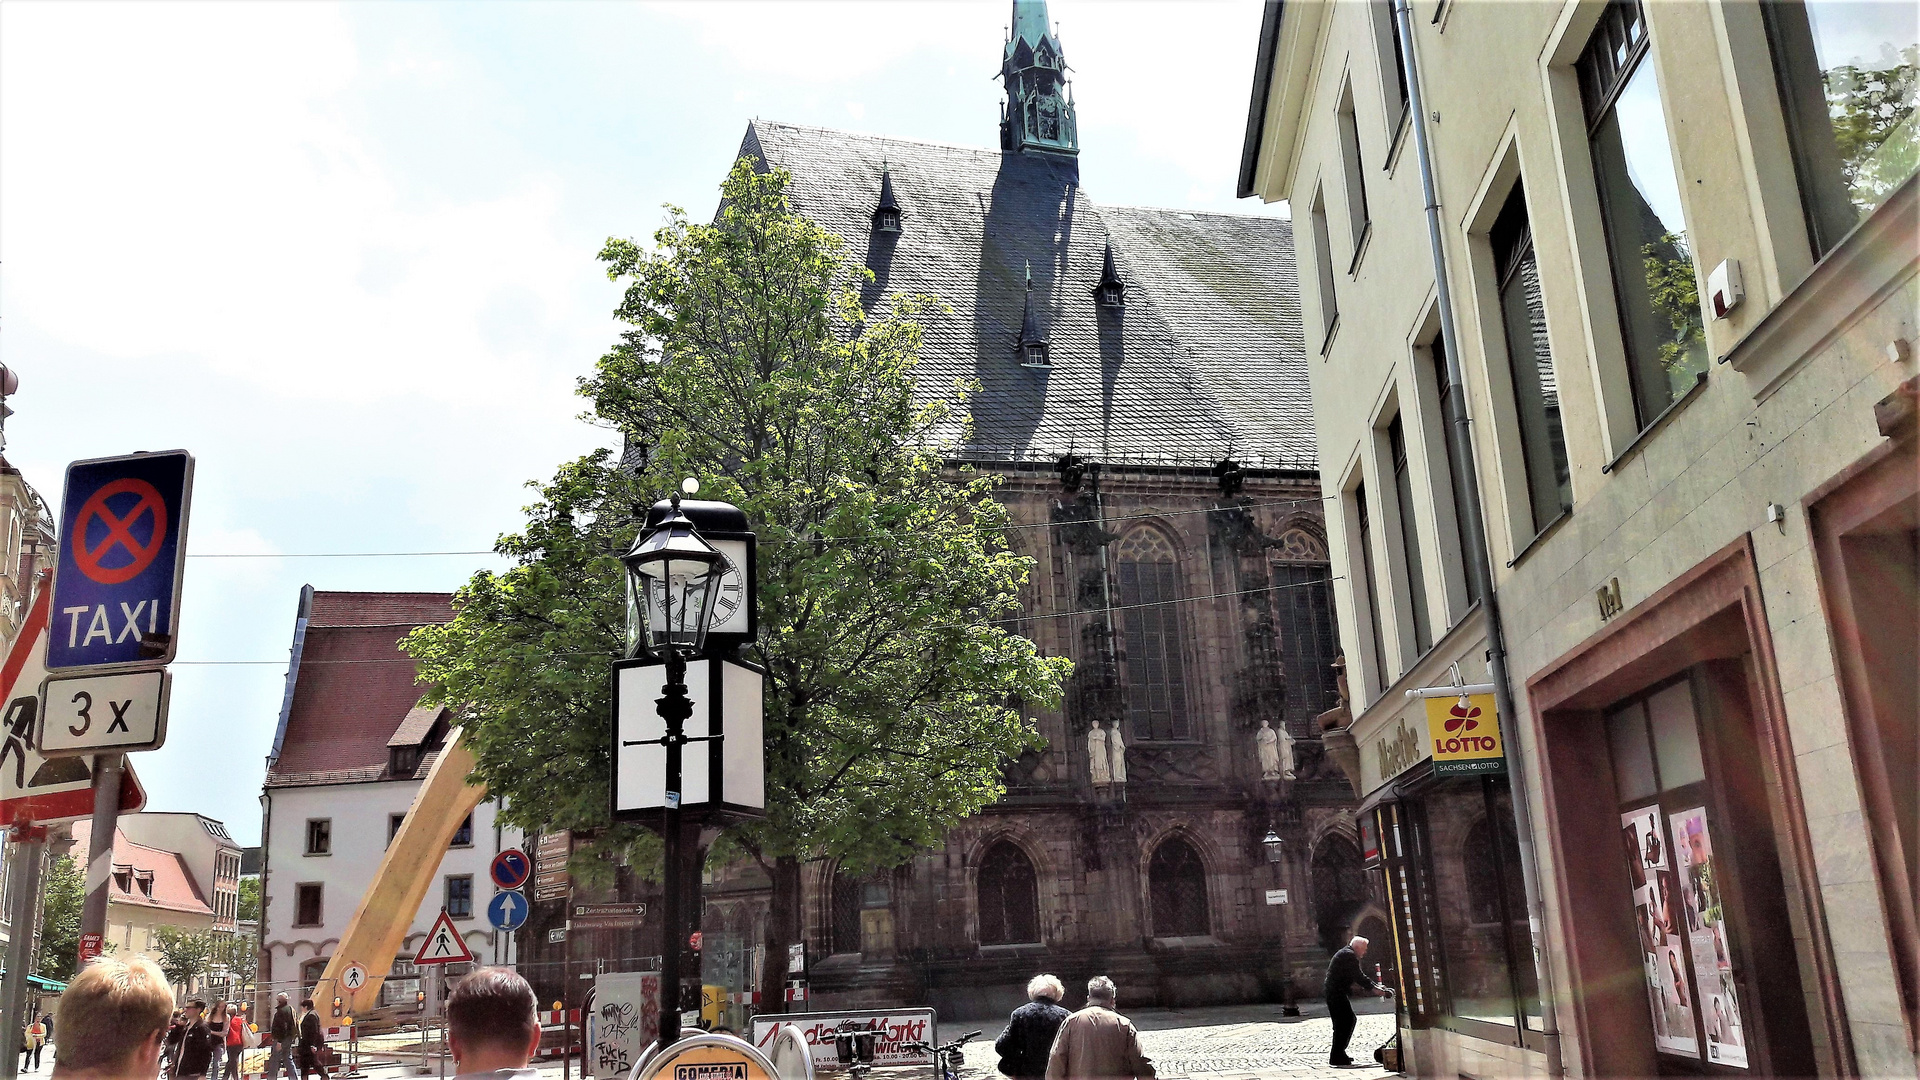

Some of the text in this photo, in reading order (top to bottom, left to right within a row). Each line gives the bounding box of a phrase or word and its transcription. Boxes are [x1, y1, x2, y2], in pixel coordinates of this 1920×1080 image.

[63, 599, 158, 648] TAXI
[68, 690, 93, 738] 3
[1436, 736, 1496, 754] LOTTO
[758, 1021, 836, 1048] Mdia
[595, 1041, 628, 1061] FUCK
